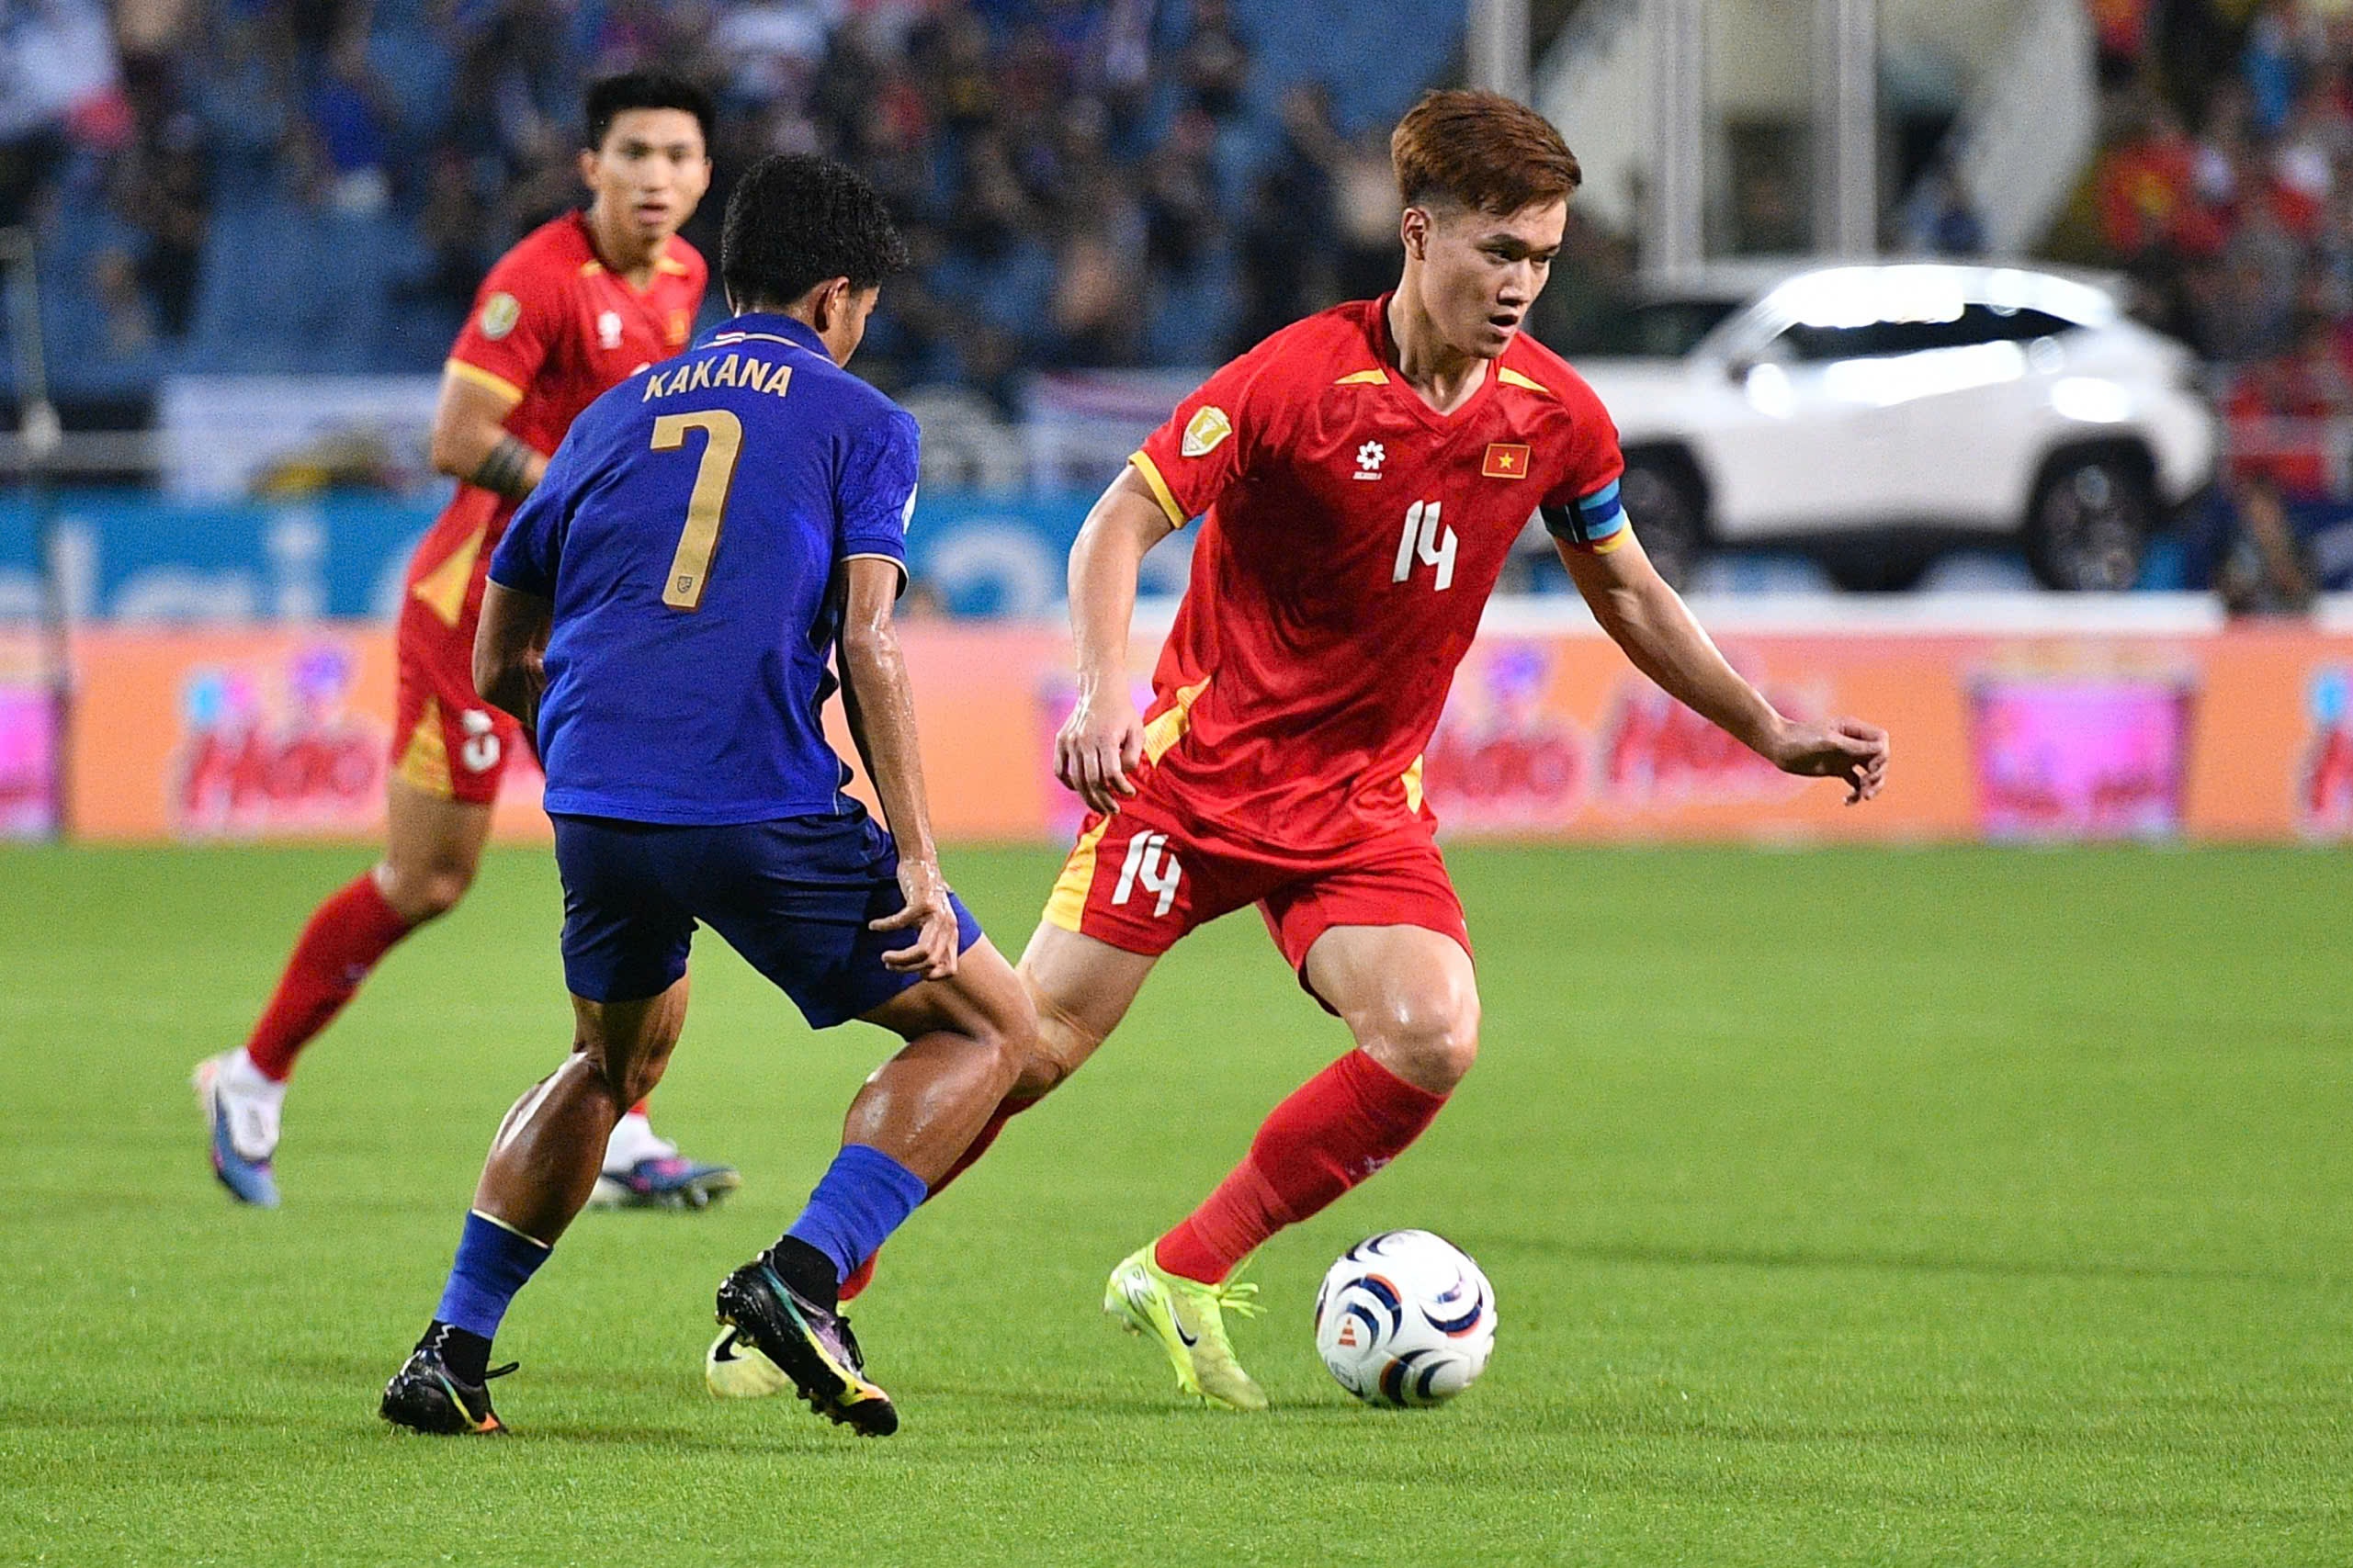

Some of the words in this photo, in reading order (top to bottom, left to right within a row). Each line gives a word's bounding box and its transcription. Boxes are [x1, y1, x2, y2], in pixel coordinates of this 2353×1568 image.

[642, 354, 793, 402] KAKANA
[650, 409, 742, 612] 7
[1392, 499, 1458, 592] 14
[1111, 829, 1182, 918] 14
